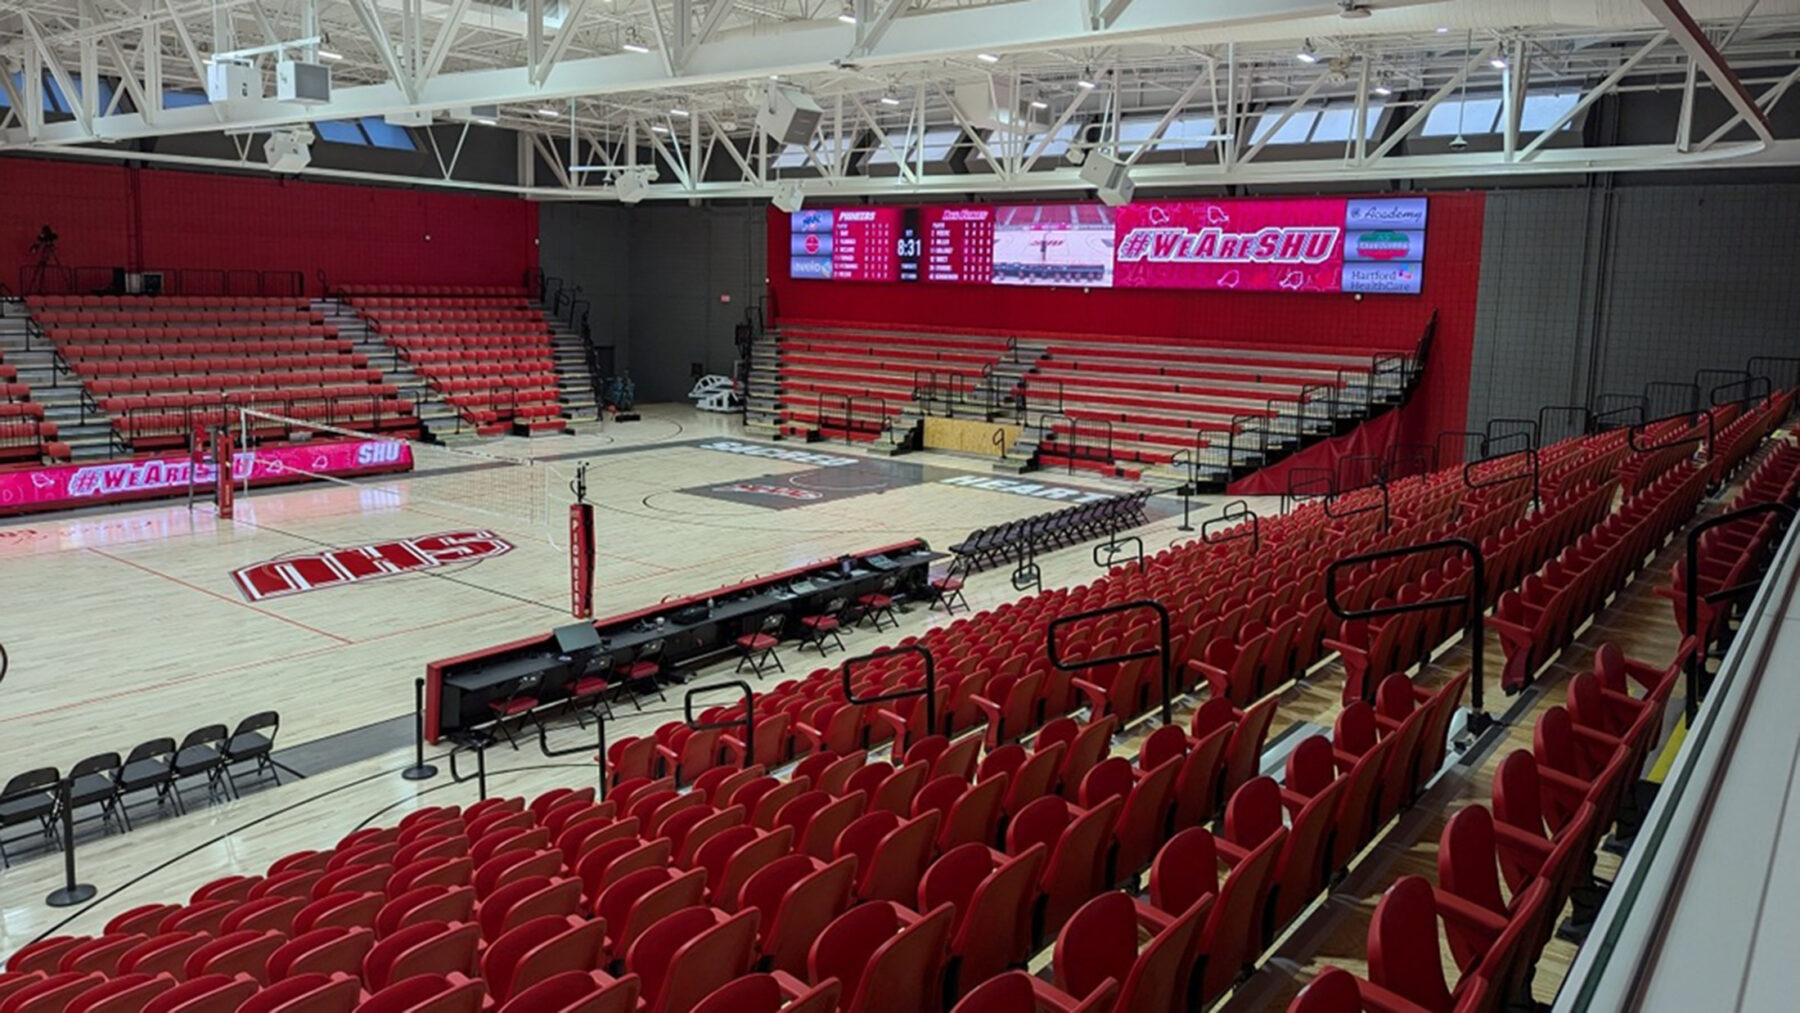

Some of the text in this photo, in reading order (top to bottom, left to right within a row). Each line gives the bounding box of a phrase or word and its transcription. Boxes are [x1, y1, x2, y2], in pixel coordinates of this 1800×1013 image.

[1364, 206, 1423, 223] Academy
[897, 238, 921, 257] 8:31
[1351, 271, 1397, 281] Hartford
[1350, 281, 1411, 291] HealthCare
[357, 441, 401, 465] SHU
[940, 475, 1115, 503] HEART
